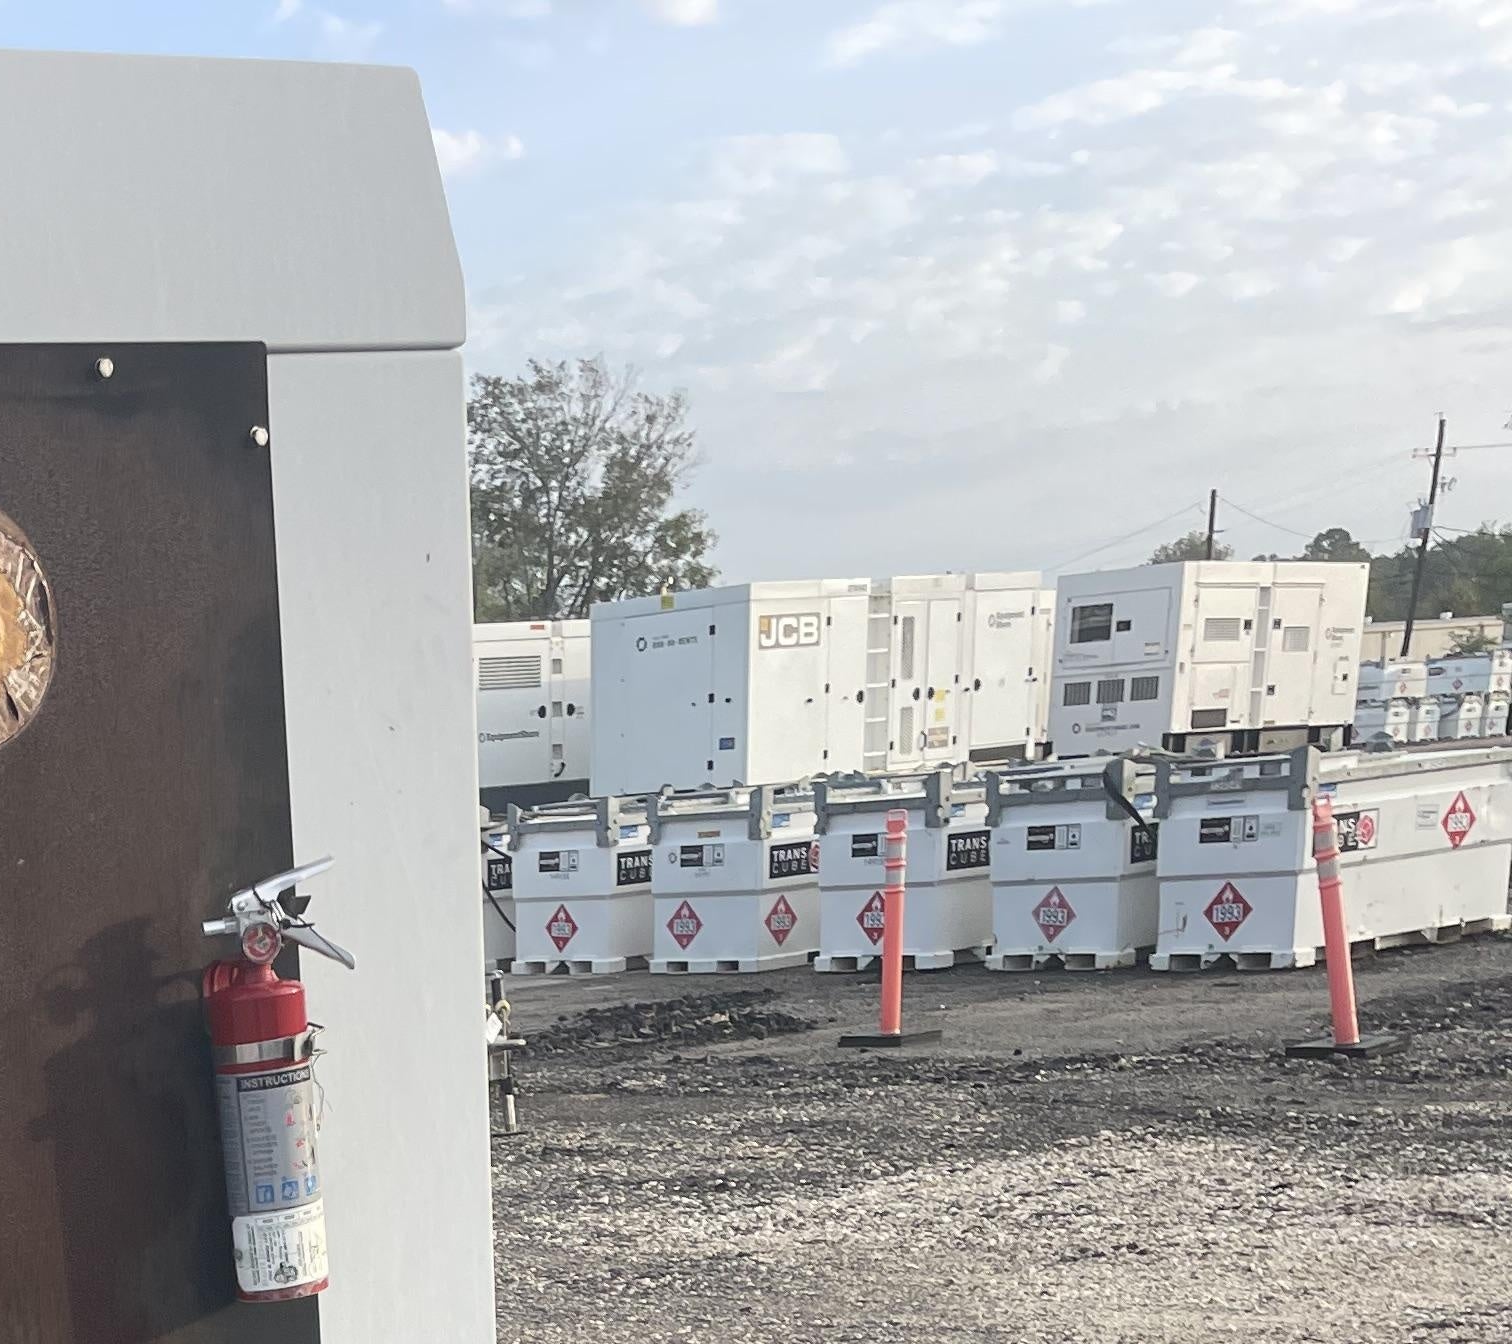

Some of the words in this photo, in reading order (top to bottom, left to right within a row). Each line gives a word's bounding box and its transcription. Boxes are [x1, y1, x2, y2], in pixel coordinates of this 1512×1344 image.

[760, 615, 819, 648] JCB
[950, 836, 987, 852] TRANS
[772, 847, 808, 862] TRANS
[949, 850, 986, 865] CUBE
[772, 859, 807, 874] CUBE
[865, 913, 884, 927] 199
[1042, 909, 1066, 924] 1993
[1215, 904, 1243, 921] 1993
[675, 920, 696, 934] 1993
[1224, 927, 1230, 935] 3
